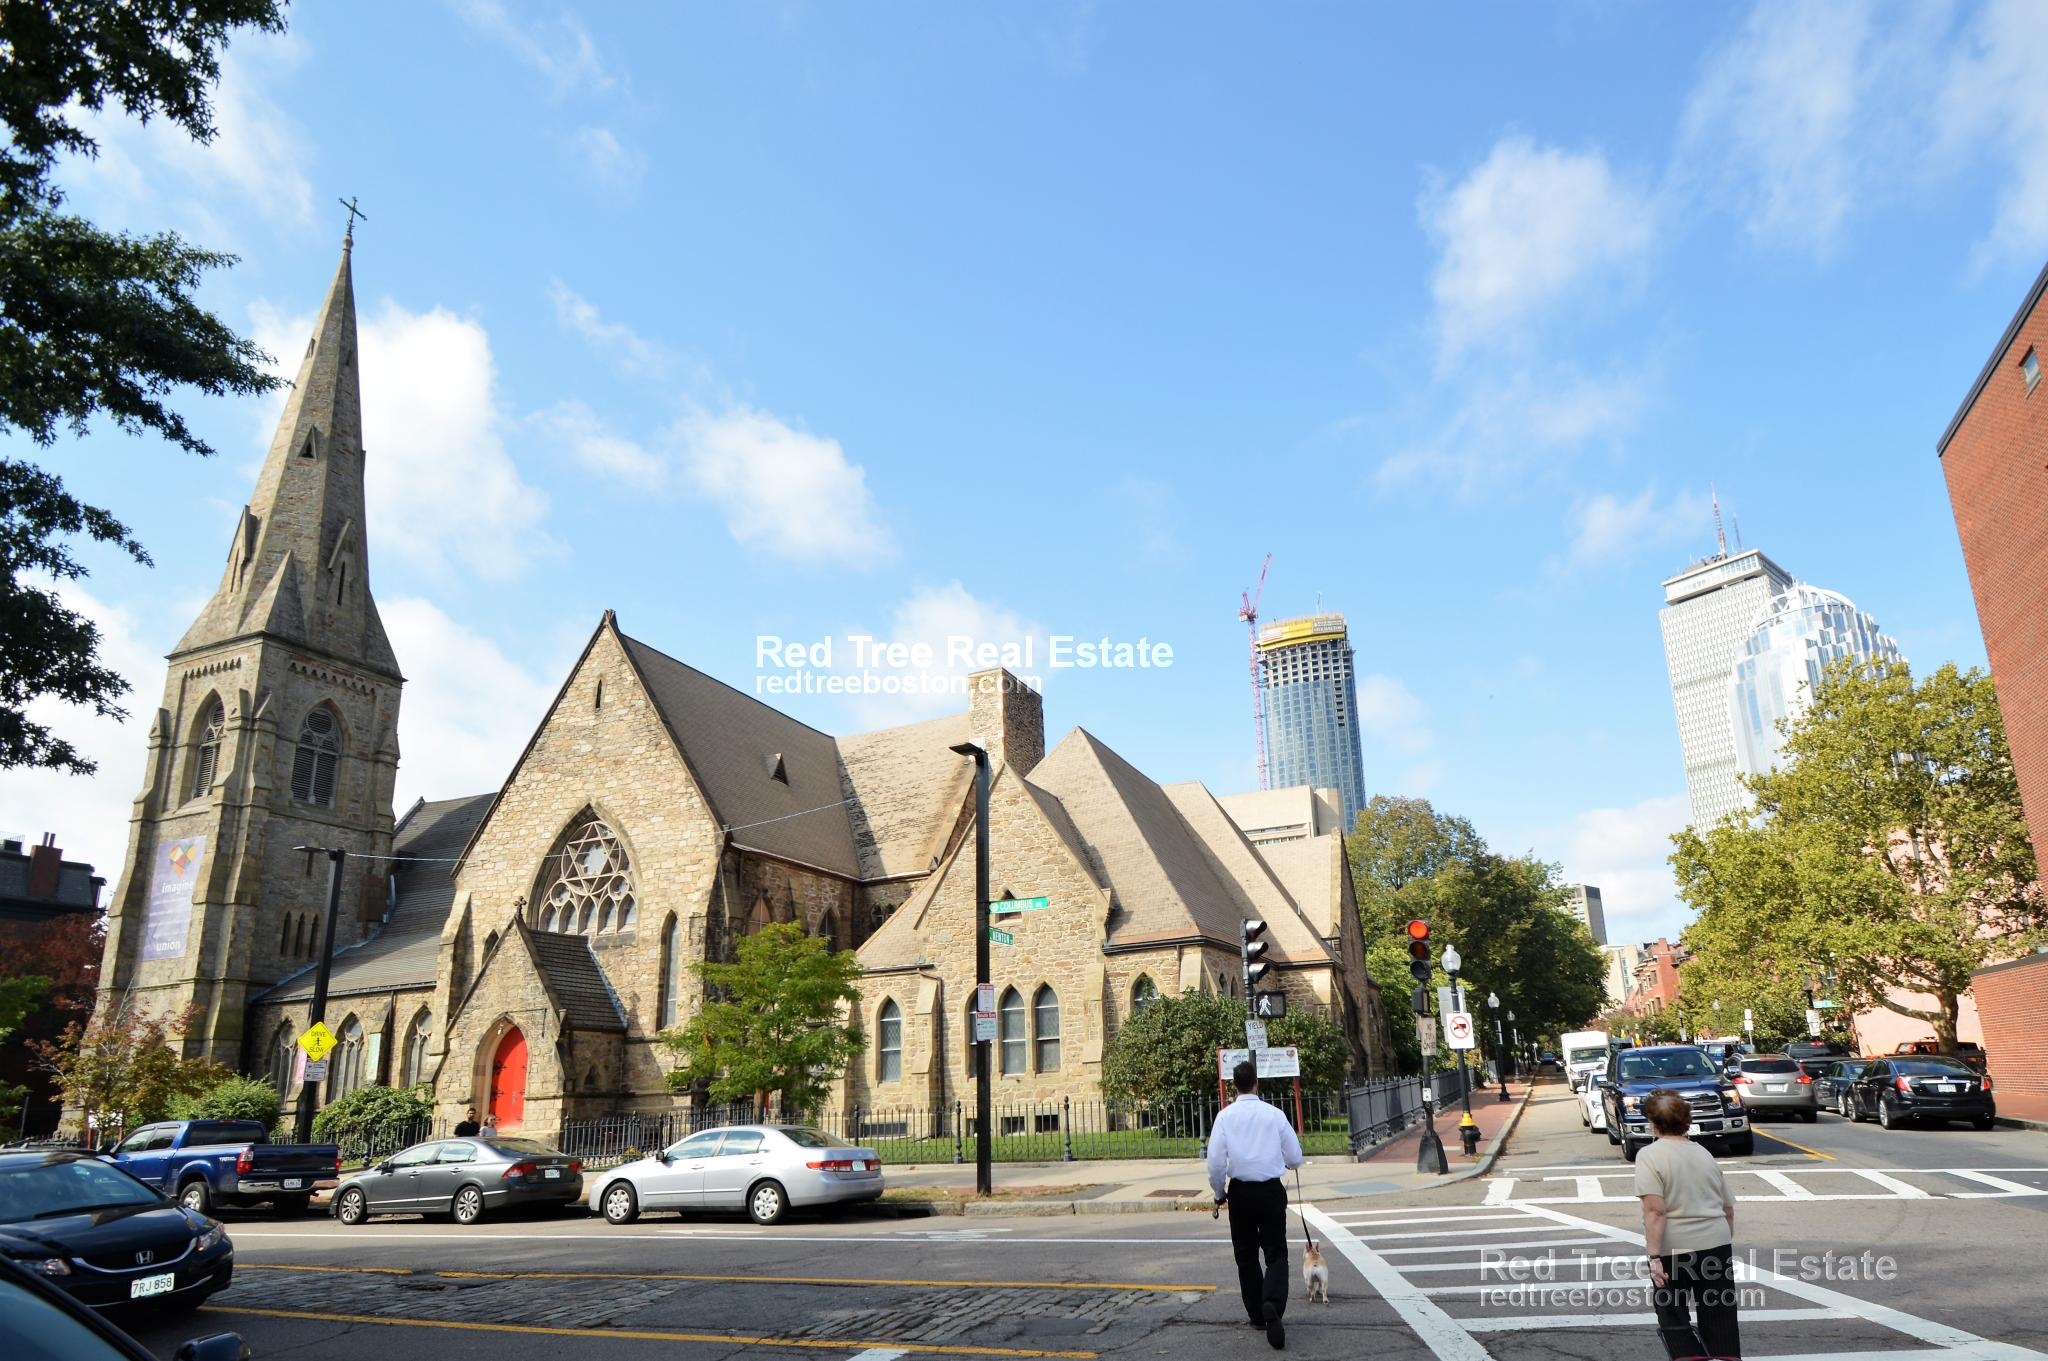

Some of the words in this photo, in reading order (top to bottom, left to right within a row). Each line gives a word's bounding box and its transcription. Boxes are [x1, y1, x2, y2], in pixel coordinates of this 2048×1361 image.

[999, 899, 1032, 911] COLUMBUS
[155, 938, 181, 952] union
[1248, 1021, 1264, 1030] YIELD
[133, 1281, 152, 1295] 7RJ
[154, 1277, 172, 1290] 858
